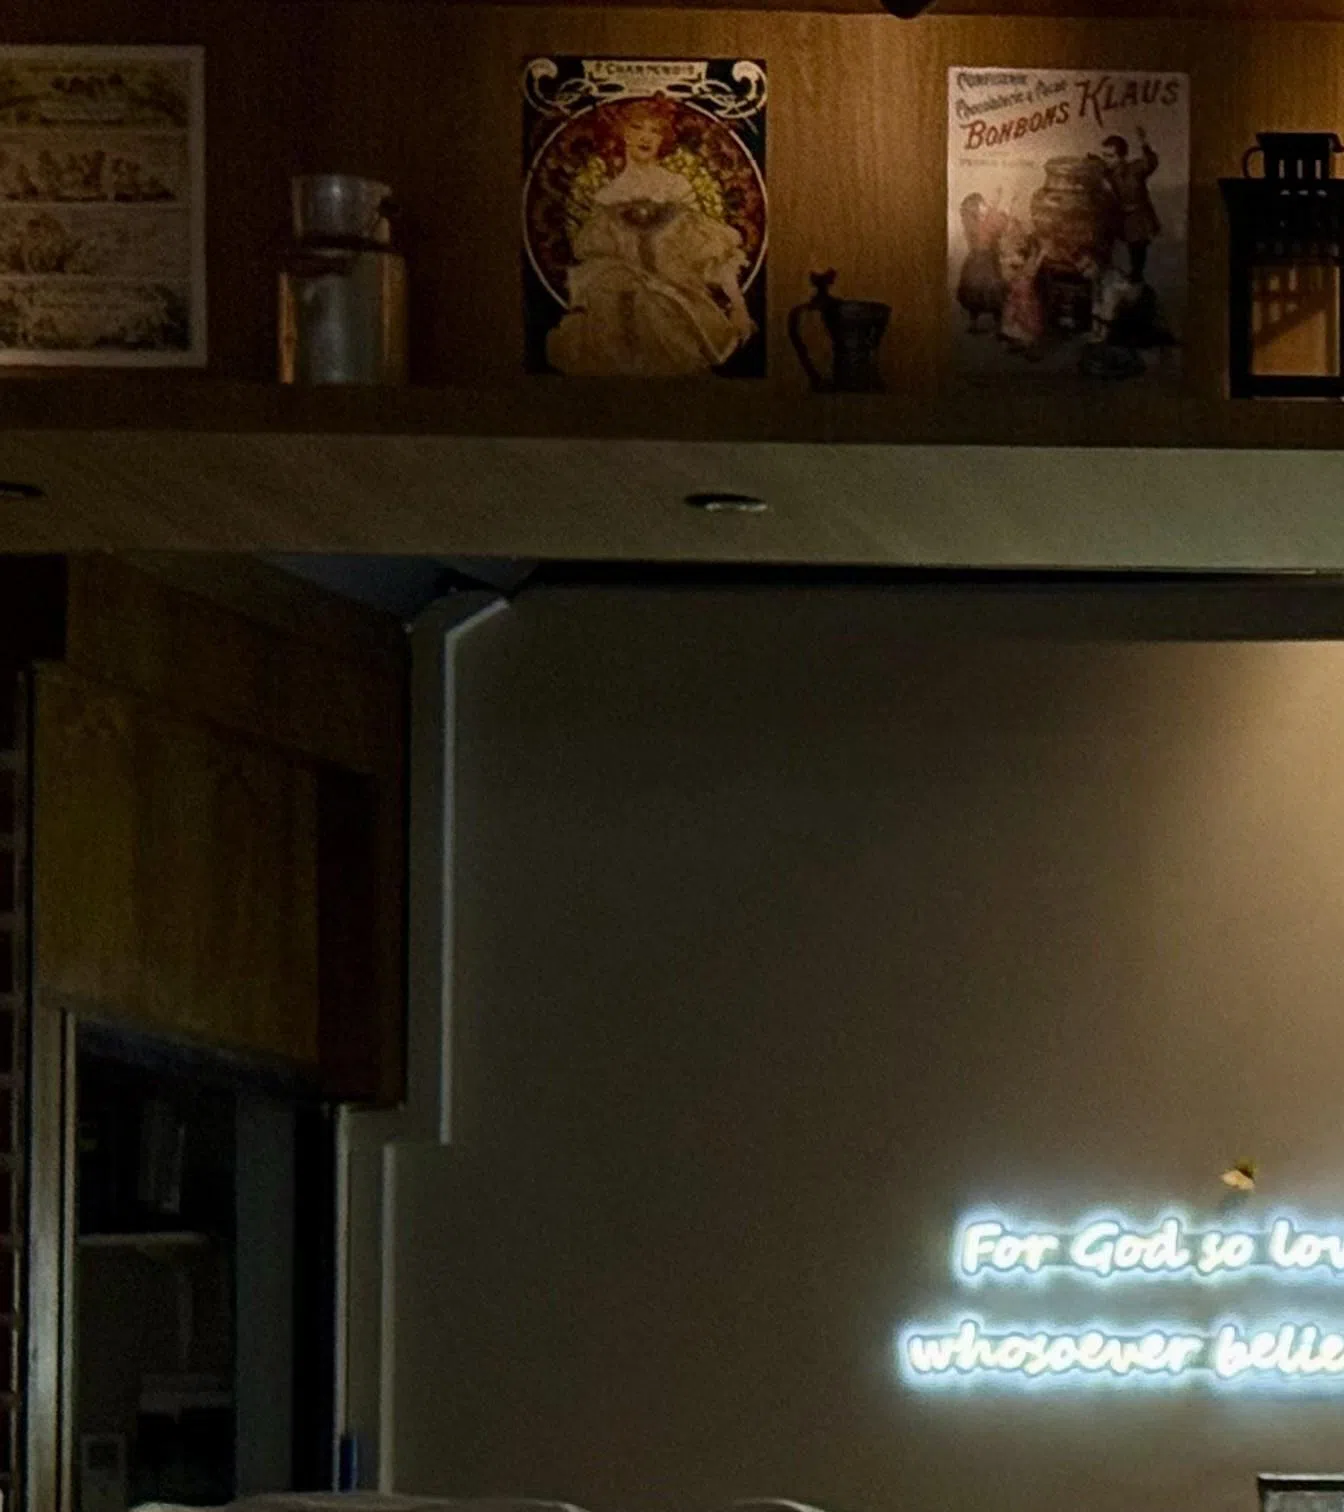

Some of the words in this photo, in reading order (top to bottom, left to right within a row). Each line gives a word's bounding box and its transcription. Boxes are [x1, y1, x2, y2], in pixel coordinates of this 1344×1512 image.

[960, 101, 1071, 150] BONBONS
[1075, 76, 1180, 128] KLAUS
[962, 1222, 1059, 1273] For
[1070, 1217, 1190, 1274] God
[1199, 1230, 1256, 1272] so
[908, 1320, 1203, 1374] whosoever
